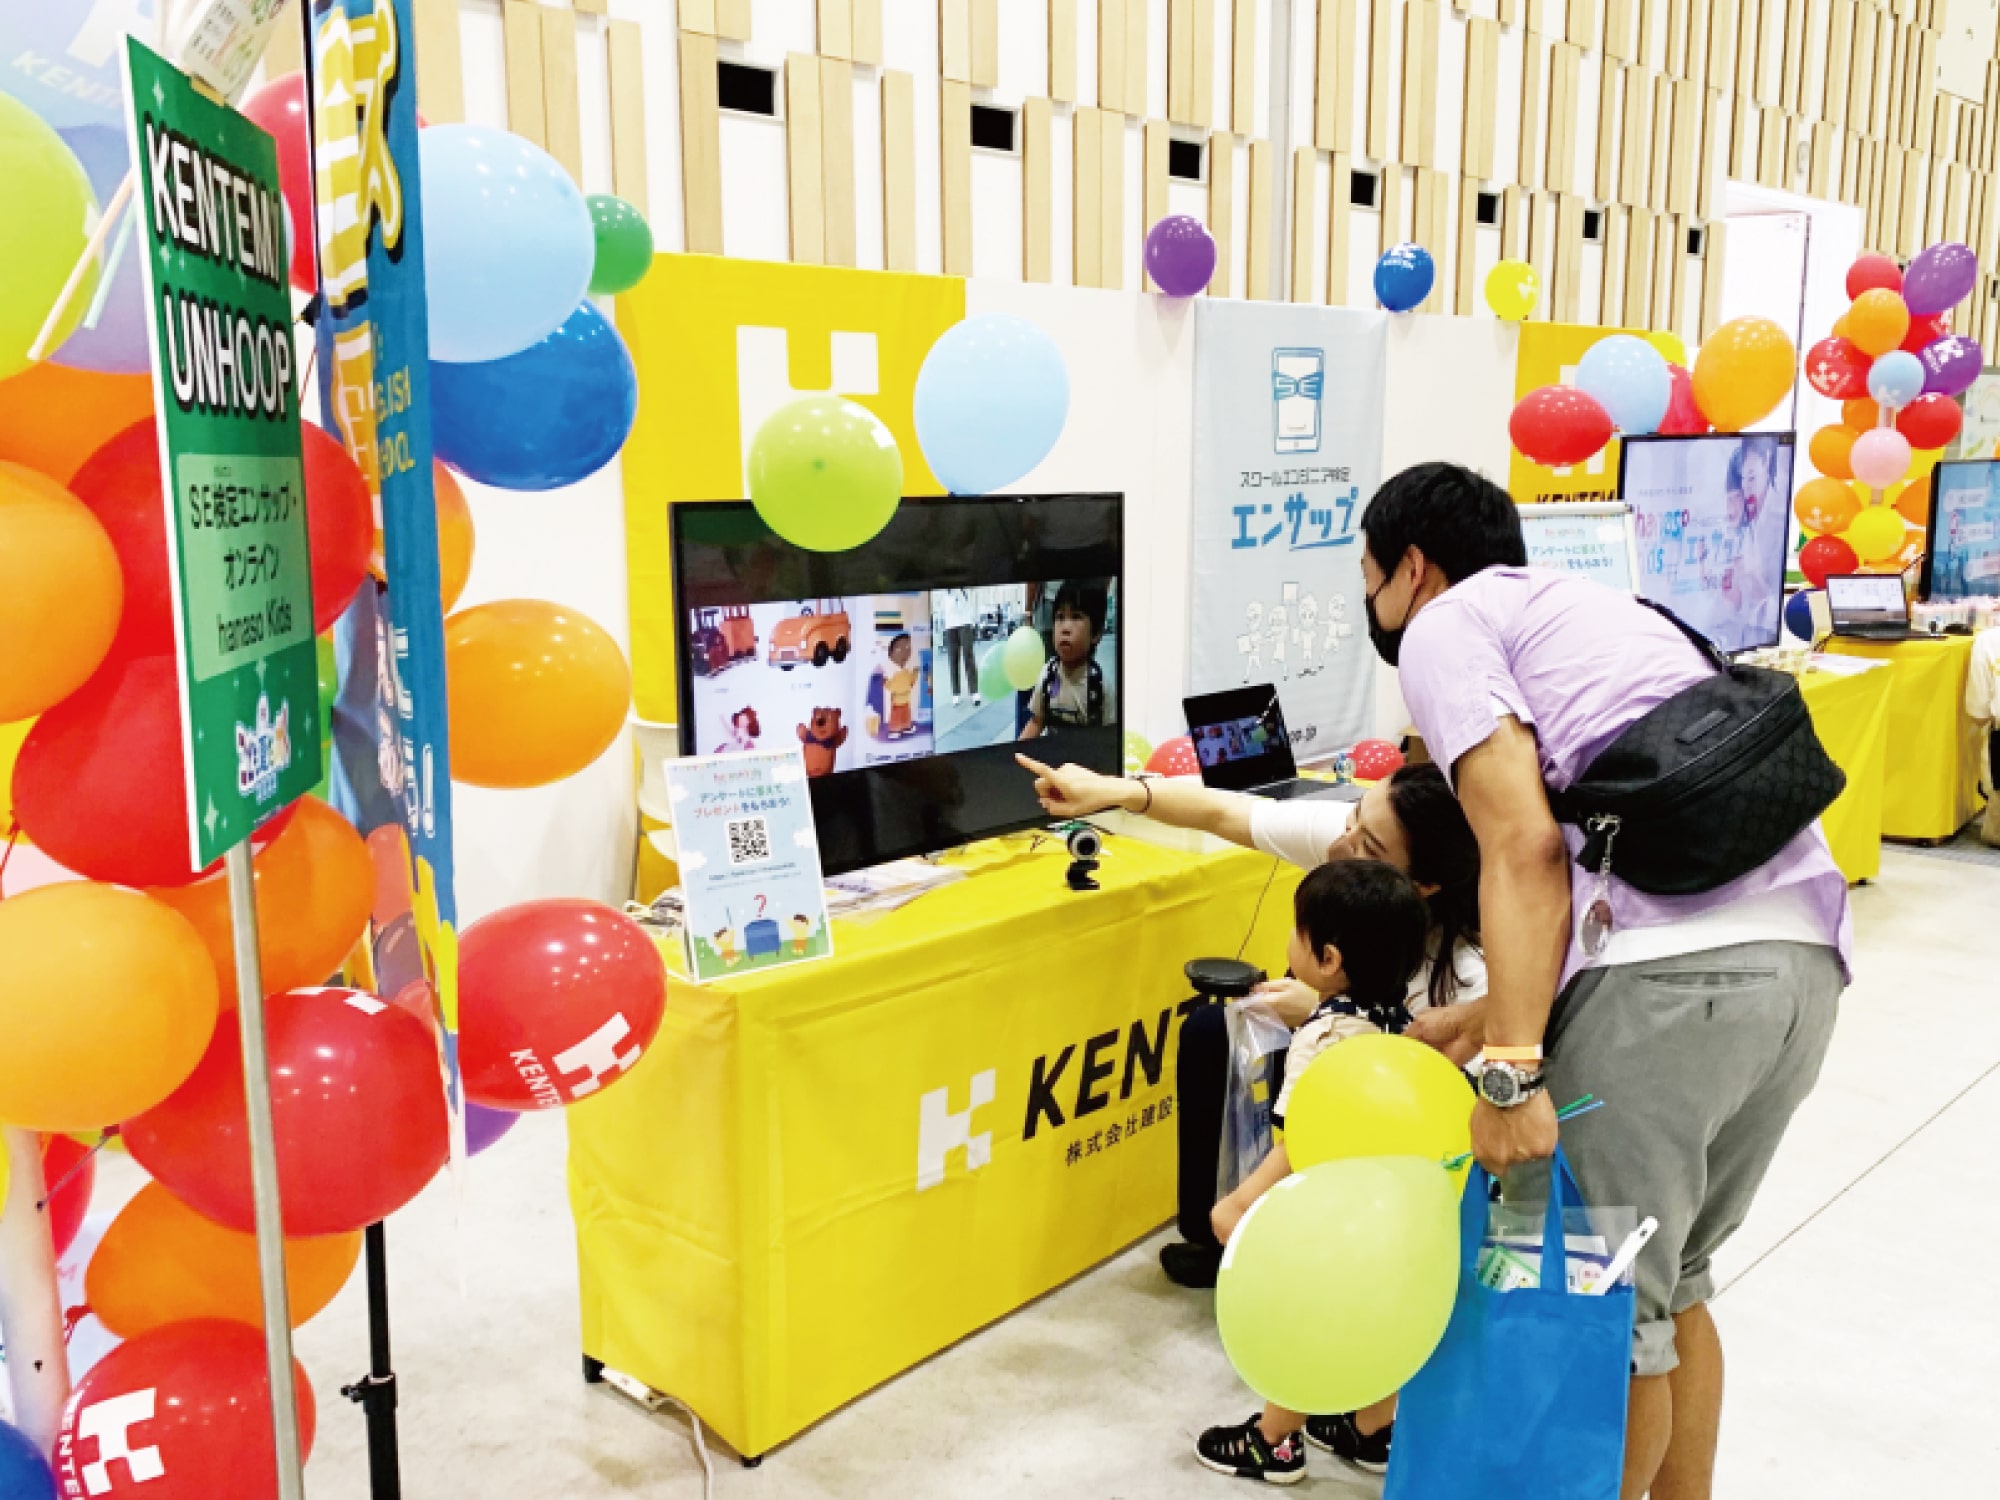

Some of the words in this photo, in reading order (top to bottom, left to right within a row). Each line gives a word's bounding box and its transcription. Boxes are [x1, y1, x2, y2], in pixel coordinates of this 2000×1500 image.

[164, 294, 291, 414] UNHOOP
[1231, 486, 1359, 549] エンサップ
[224, 543, 280, 592] オンライン
[1065, 1095, 1173, 1167] 株式会社建設
